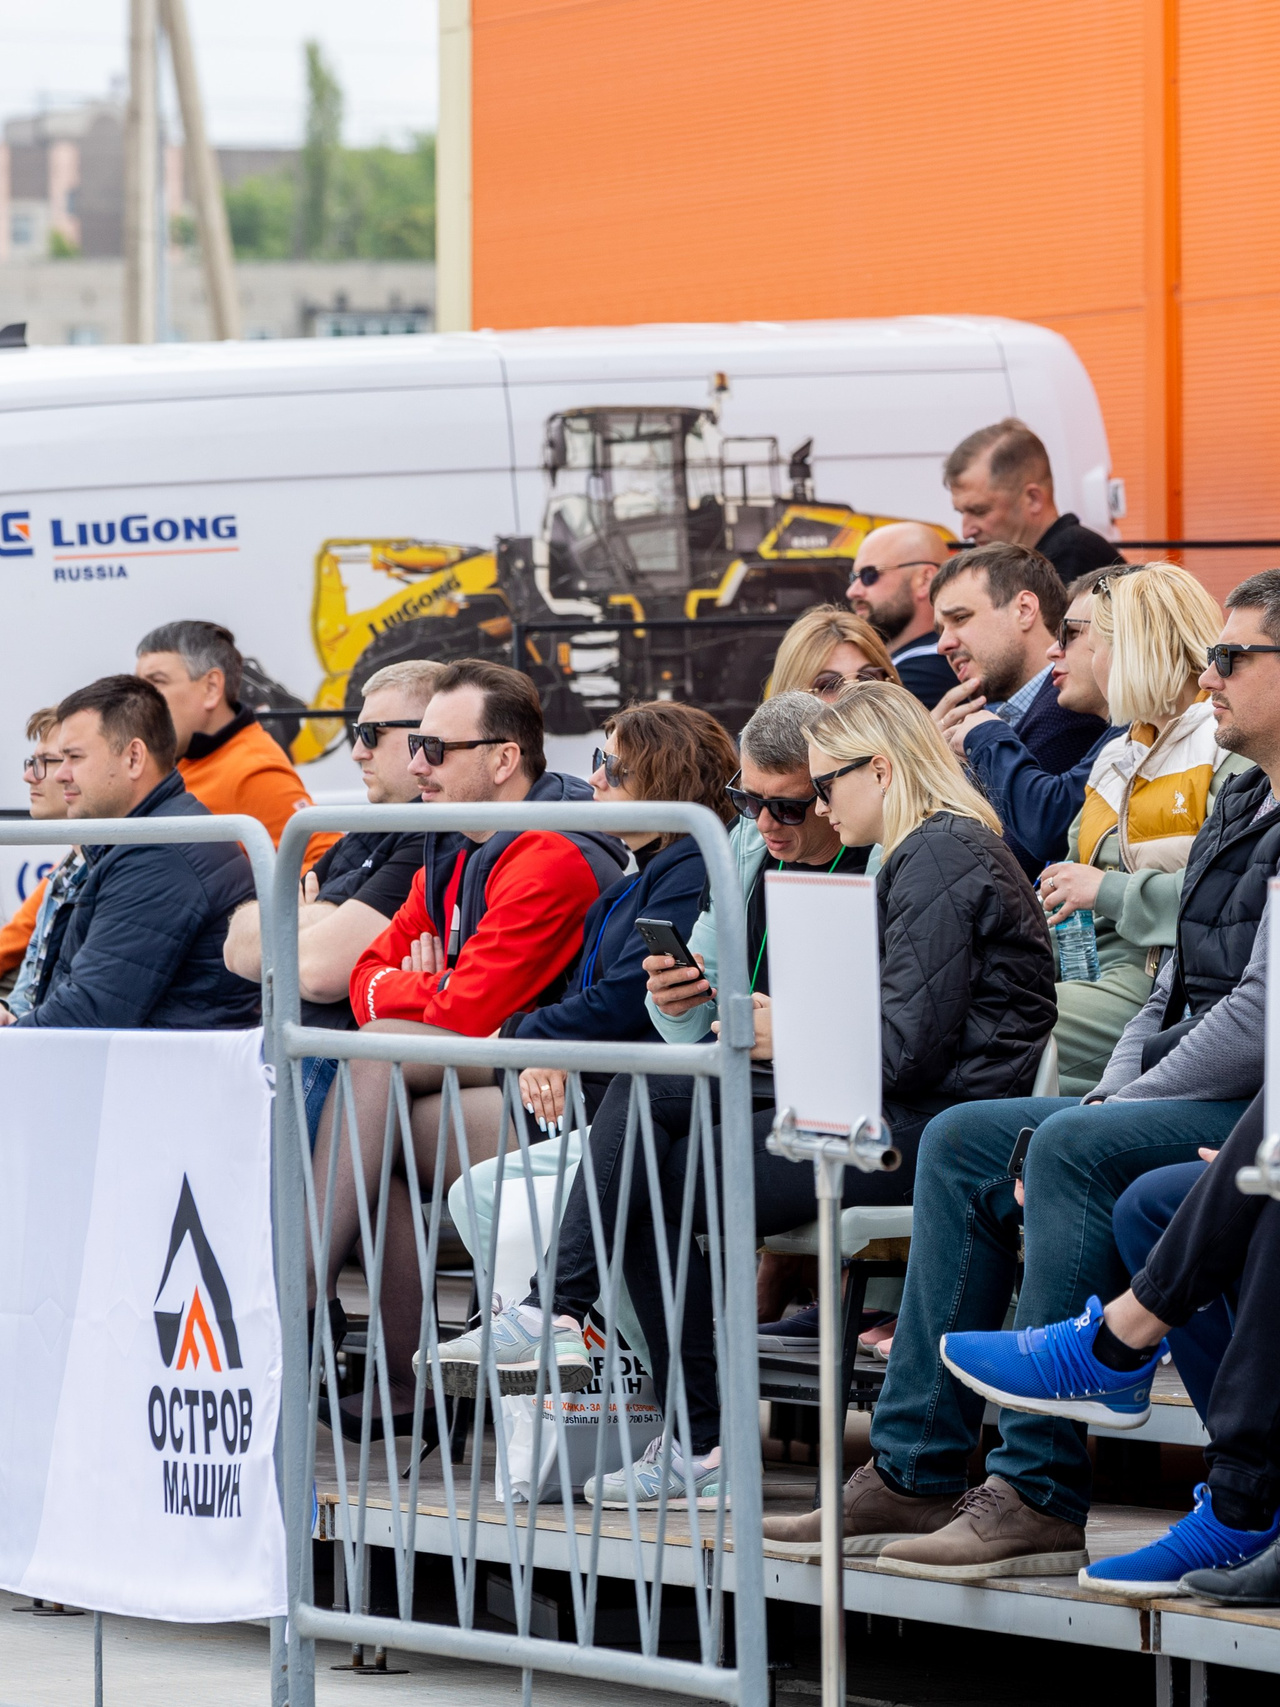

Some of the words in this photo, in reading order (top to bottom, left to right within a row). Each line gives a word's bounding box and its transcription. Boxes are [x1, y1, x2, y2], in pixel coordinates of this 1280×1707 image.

[53, 564, 129, 582] RUSSIA
[148, 1385, 252, 1455] ОСТРОВ
[532, 1398, 586, 1413] СЕЦХНИКА
[163, 1460, 242, 1518] МАШИН
